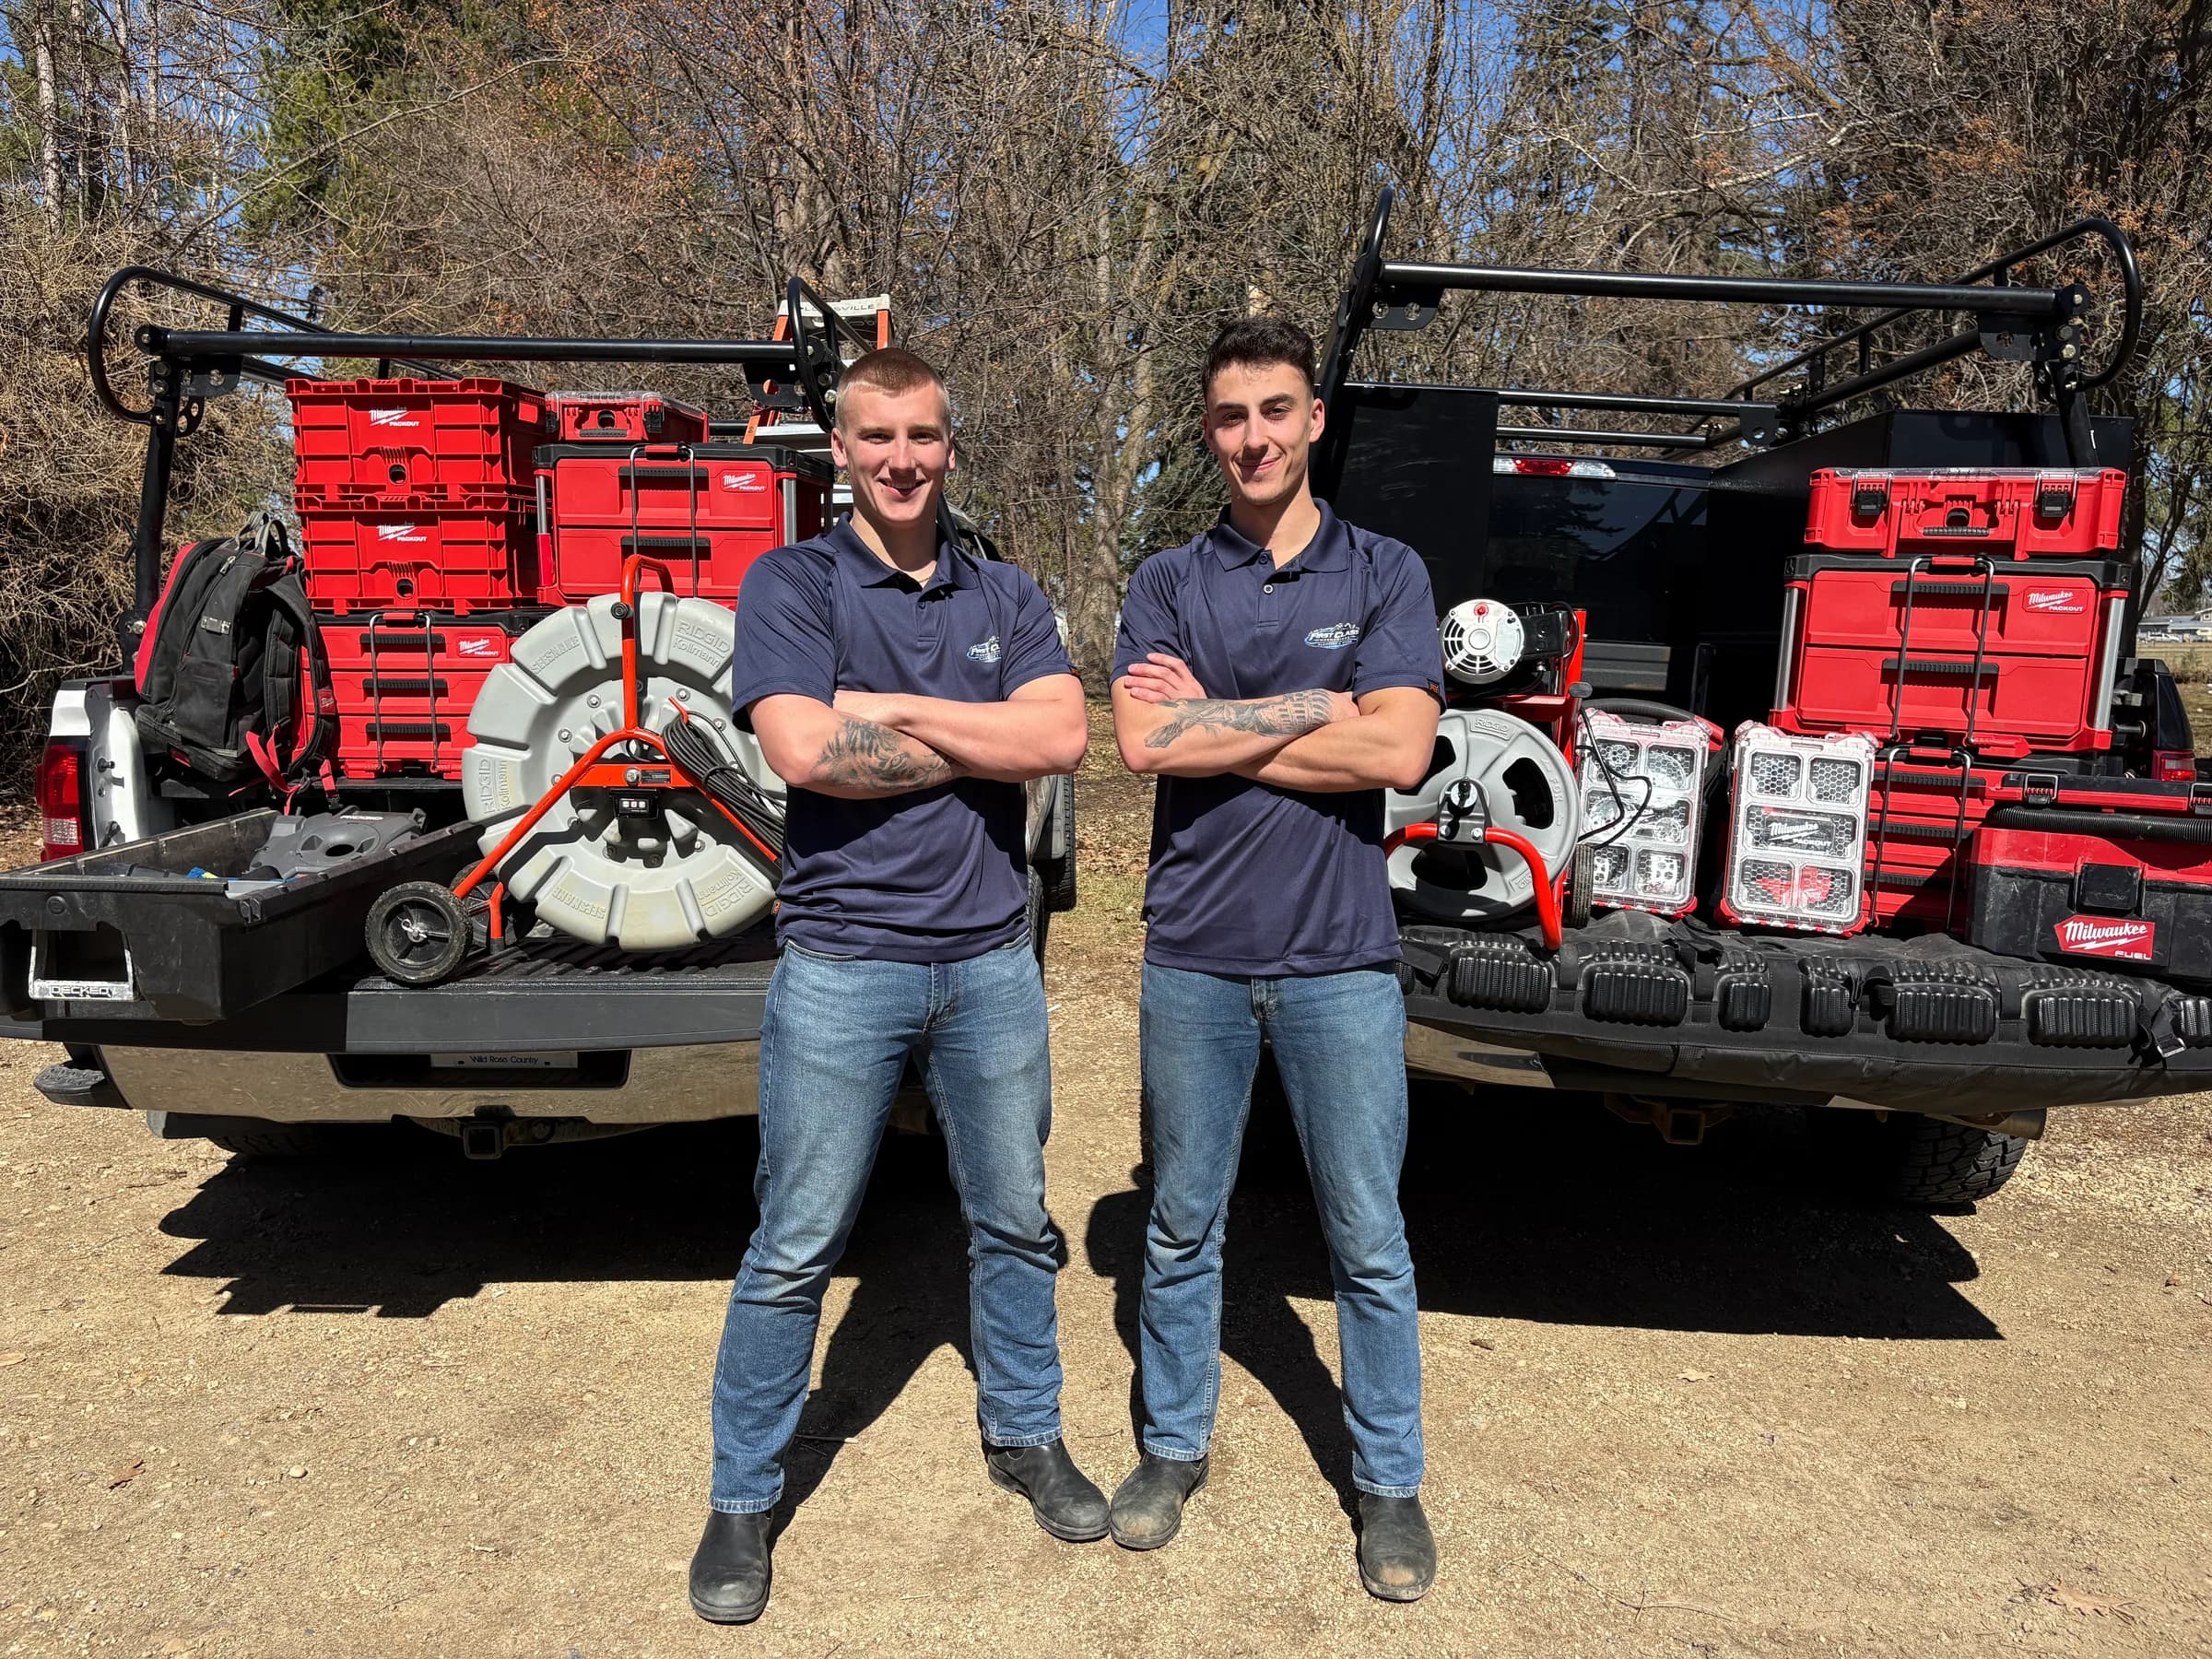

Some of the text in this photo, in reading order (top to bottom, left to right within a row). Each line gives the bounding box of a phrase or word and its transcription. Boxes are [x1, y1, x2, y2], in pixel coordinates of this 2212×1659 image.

[2027, 591, 2074, 606] Milwaukee
[677, 619, 731, 653] RIDGID
[1309, 632, 1335, 641] FIRST
[673, 637, 722, 668] Kollmann
[1475, 718, 1510, 733] RIDGID
[479, 758, 496, 815] RIDGID
[499, 760, 512, 810] Kollmann
[1768, 821, 1819, 836] Milwaukee
[1793, 838, 1832, 846] PACKOUT
[697, 869, 742, 900] Kollmann
[704, 880, 754, 917] RIDGID
[2063, 921, 2148, 944] Milwaukee
[2114, 950, 2152, 959] FUEL
[50, 985, 112, 998] DECKED
[510, 1055, 539, 1065] Country
